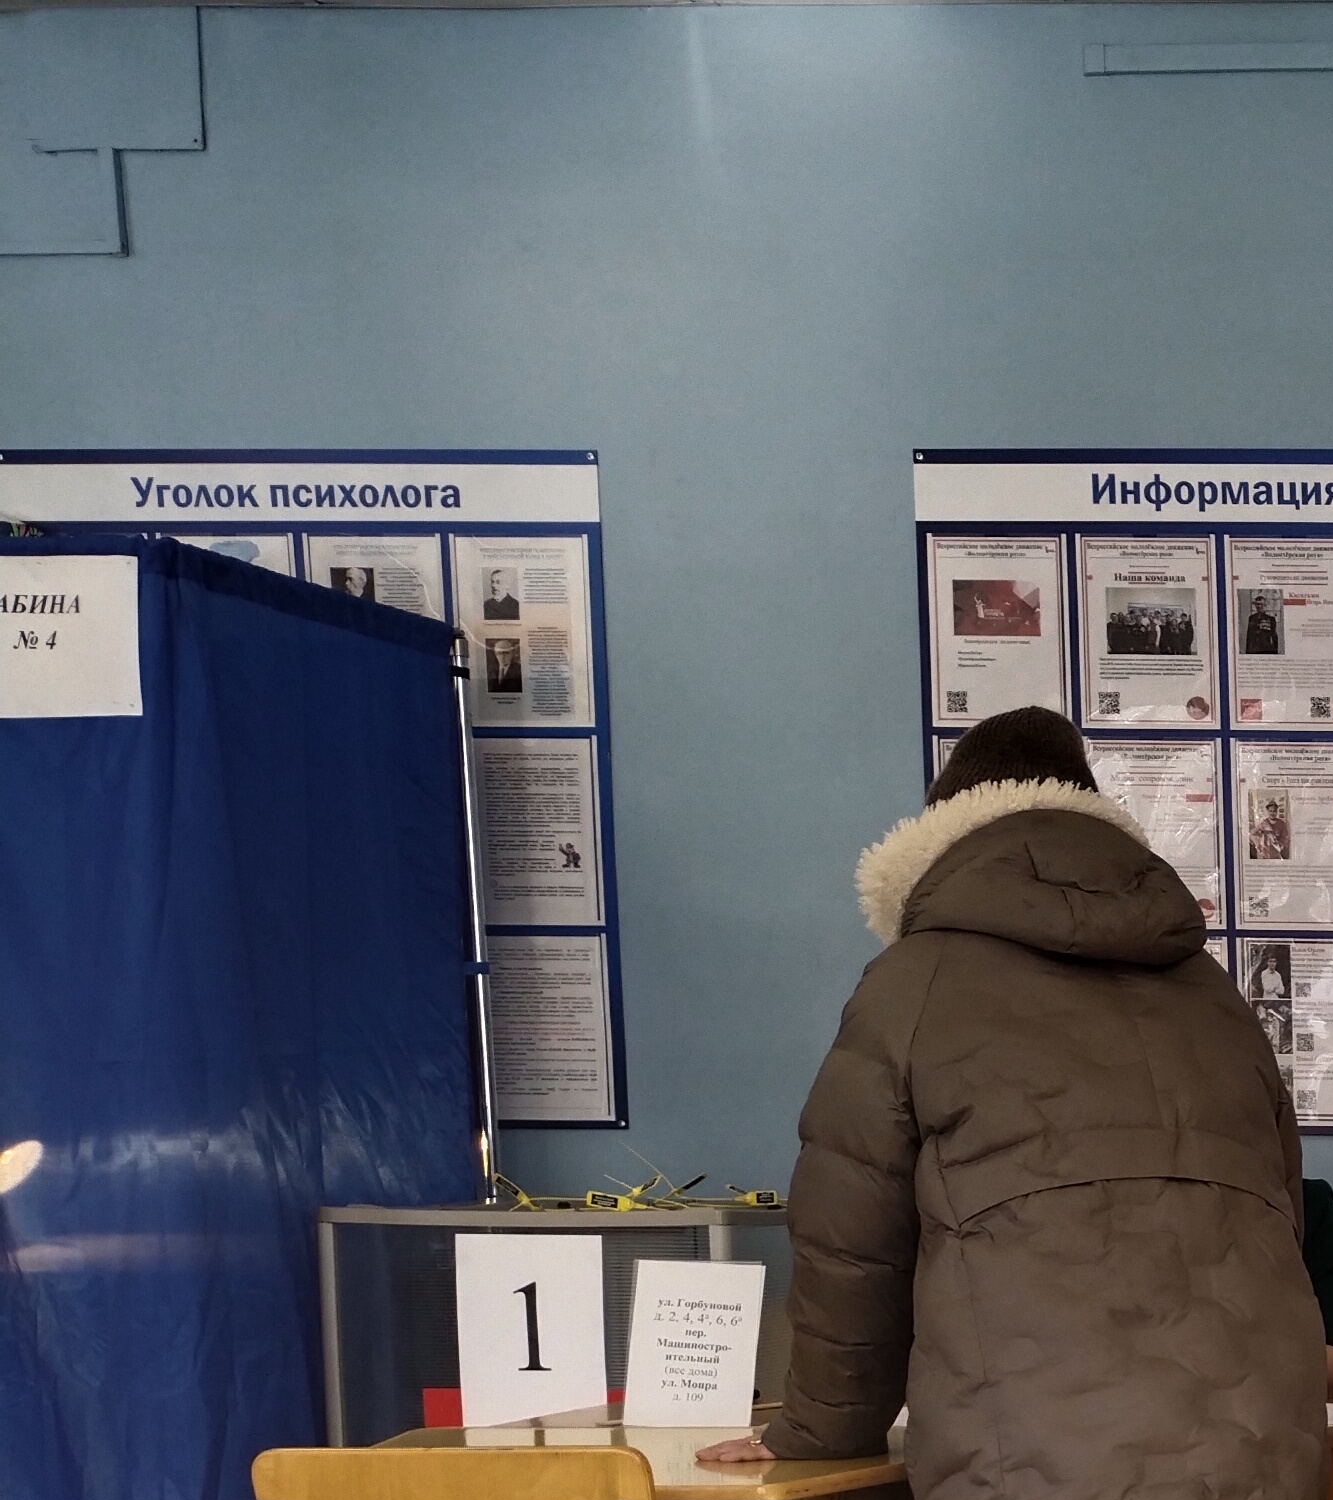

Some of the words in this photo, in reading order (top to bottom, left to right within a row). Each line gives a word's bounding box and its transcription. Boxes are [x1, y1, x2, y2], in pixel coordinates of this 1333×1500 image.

[130, 476, 260, 509] Уголок
[269, 483, 462, 509] психолога
[0, 594, 80, 614] АБИНА
[13, 630, 39, 650] №
[45, 630, 57, 650] 4
[657, 1299, 674, 1308] ул.
[676, 1298, 742, 1312] Горбуновой
[513, 1281, 552, 1372] 1
[685, 1329, 707, 1339] пер.
[656, 1338, 732, 1353] Машиностро-
[665, 1353, 720, 1364] ительный
[664, 1365, 686, 1376] (все
[688, 1367, 718, 1378] дома)
[661, 1379, 677, 1389] ул.
[680, 1379, 718, 1392] Мопра
[686, 1392, 704, 1402] 109
